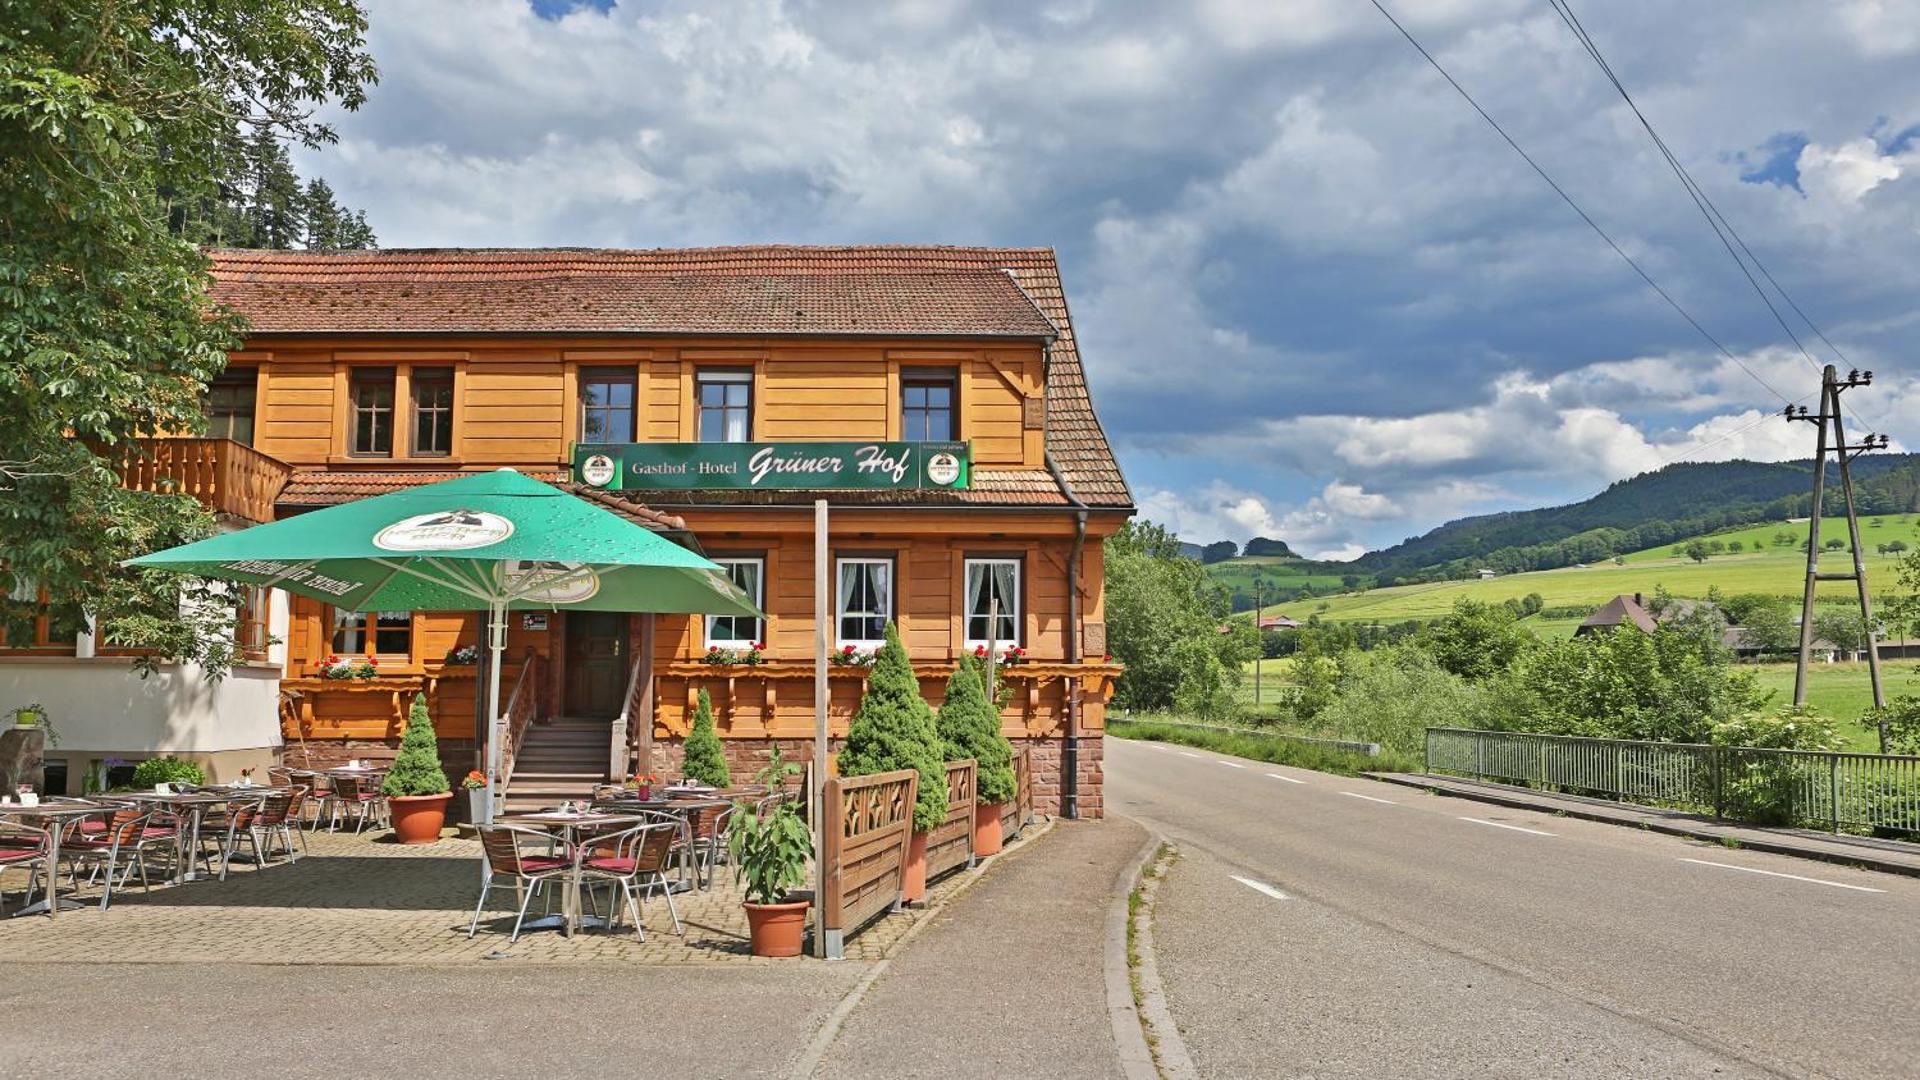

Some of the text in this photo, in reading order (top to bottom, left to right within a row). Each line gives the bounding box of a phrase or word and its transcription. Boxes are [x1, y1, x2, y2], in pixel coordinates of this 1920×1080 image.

[632, 461, 688, 475] Gasthof
[699, 461, 737, 475] Hotel
[748, 446, 844, 485] Grüner
[854, 445, 911, 483] Hof
